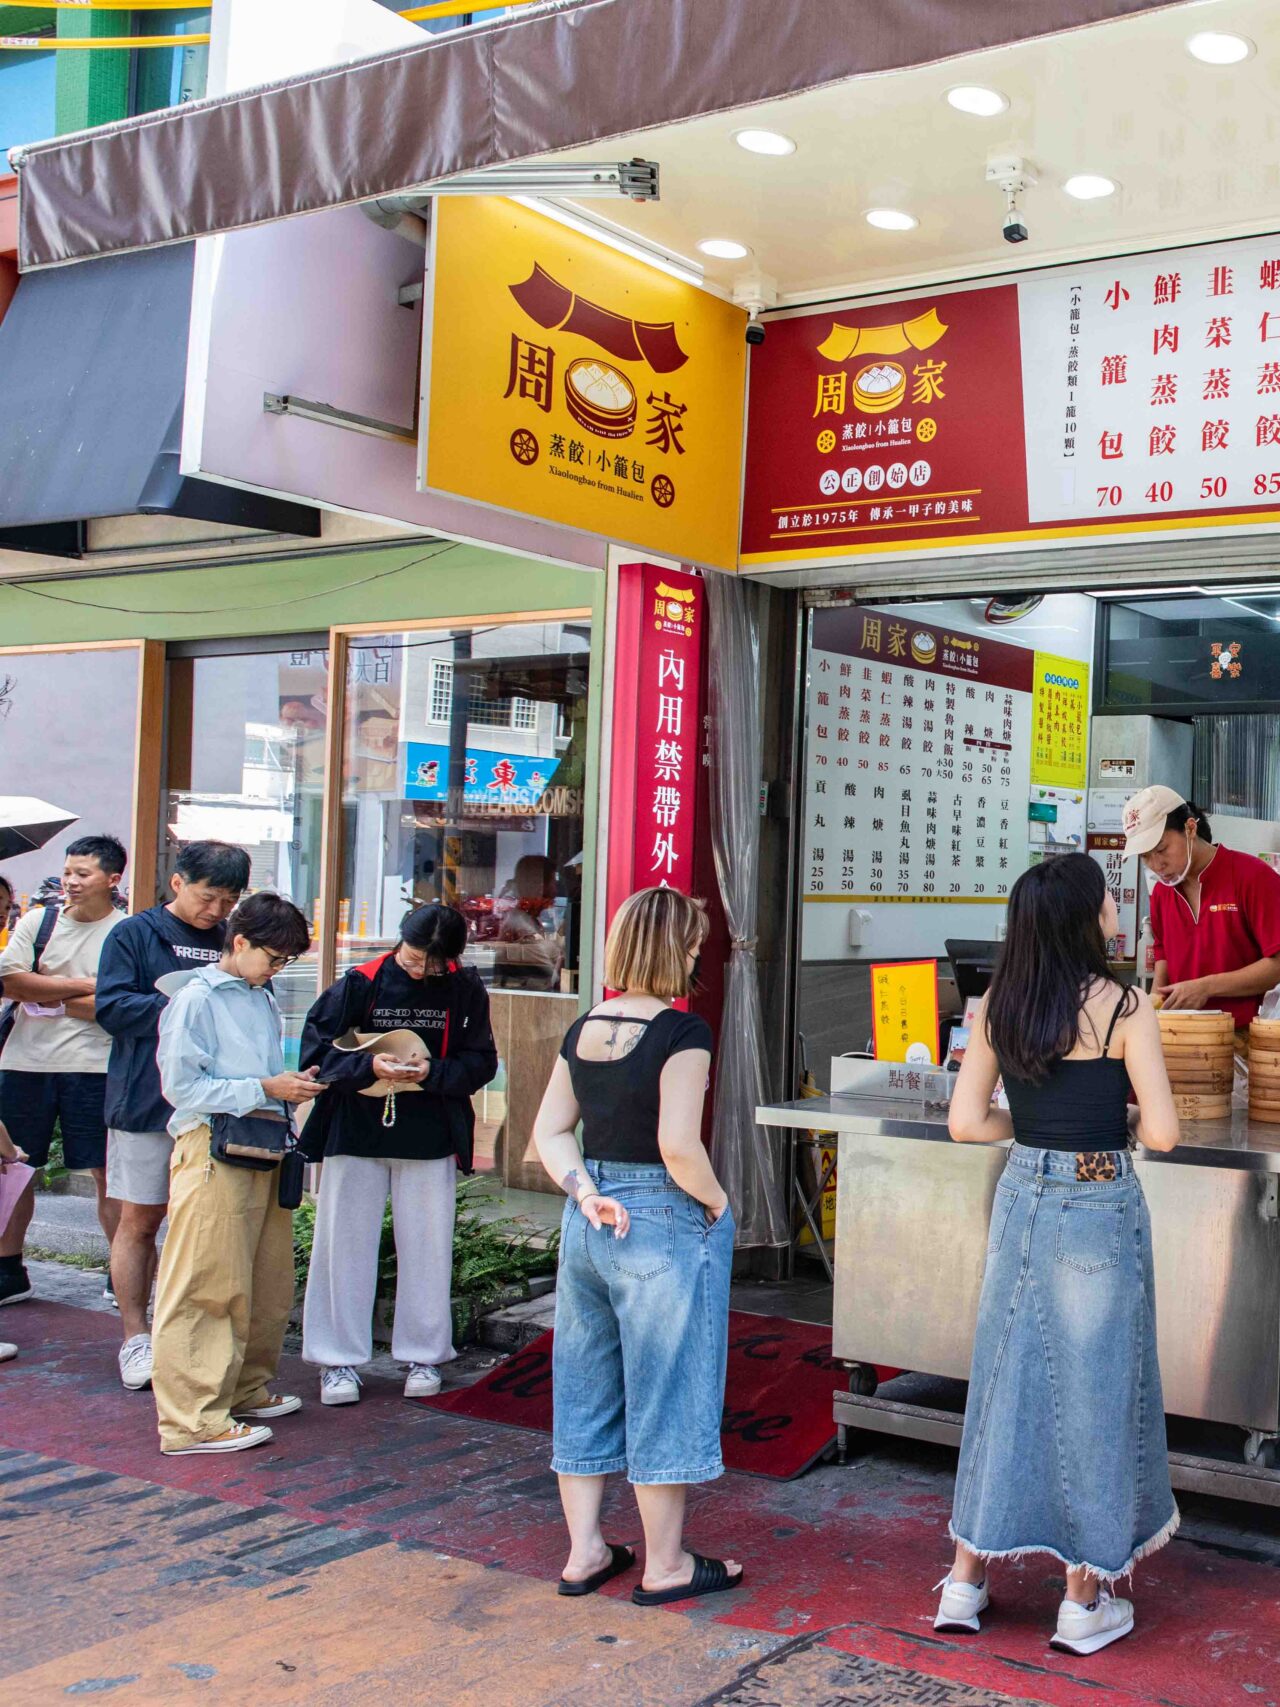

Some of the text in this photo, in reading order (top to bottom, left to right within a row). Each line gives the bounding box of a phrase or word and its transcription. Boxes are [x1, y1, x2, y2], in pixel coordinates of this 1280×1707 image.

[503, 332, 688, 455] 周 家
[813, 359, 948, 418] 周 家
[1099, 281, 1130, 459] 小籠包
[1149, 273, 1181, 456] 鮮肉蒸餃
[1202, 266, 1233, 451] 韭菜蒸餃
[822, 464, 928, 491] 公正創始店
[875, 440, 889, 449] from
[890, 438, 911, 447] Hualien
[549, 465, 644, 502] Xiaolongbao from Hualien
[778, 498, 973, 529] 創立於1975年 傳承一甲子的美味
[1097, 486, 1122, 507] 70
[1145, 481, 1173, 502] 40
[1200, 477, 1227, 498] 50
[1254, 473, 1280, 495] 85
[860, 616, 908, 657] 周家
[817, 659, 830, 738] 小籠包
[838, 663, 851, 741] 鮮肉蒸餃
[859, 667, 871, 744] 韭菜蒸餃
[880, 671, 892, 747] 蝦仁蒸餃
[902, 675, 914, 750] 酸辣湯餃
[650, 649, 685, 890] 內用禁帶外
[816, 755, 932, 777] 70 40 50 85 65 70
[962, 762, 1011, 775] 50 50 60
[962, 774, 1010, 787] 65 65 75
[813, 781, 826, 861] 貢丸湯
[843, 783, 856, 862] 酸辣湯
[952, 794, 962, 866] 古早味紅茶
[999, 800, 1008, 868] 豆香紅茶
[810, 880, 1007, 893] 50 50 60 70 80 20 20 20
[811, 866, 935, 879] 25 25 30 35 40
